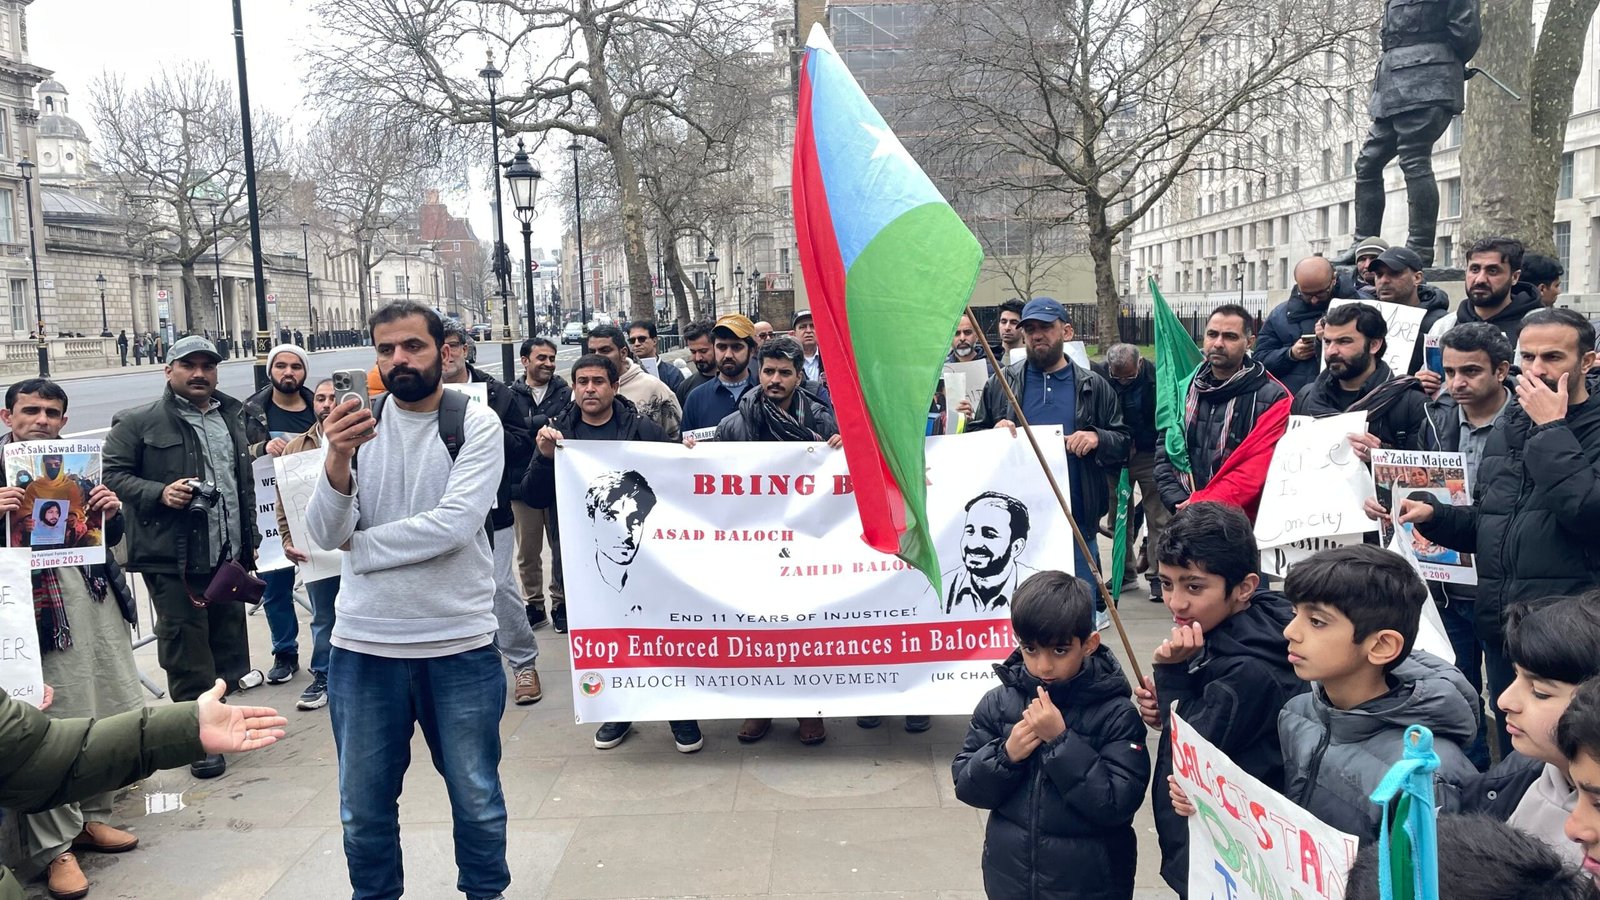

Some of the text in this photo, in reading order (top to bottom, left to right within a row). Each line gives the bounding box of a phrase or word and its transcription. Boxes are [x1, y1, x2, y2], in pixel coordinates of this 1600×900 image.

[27, 445, 46, 454] Saki
[48, 444, 75, 453] Sawad
[77, 443, 100, 453] Baloch
[1390, 453, 1418, 465] Zakir
[1421, 455, 1462, 468] Majeed
[693, 474, 815, 496] BRING
[259, 503, 275, 513] INT
[652, 528, 794, 542] ASAD BALOCH
[778, 547, 791, 559] &
[30, 559, 41, 567] 05
[62, 555, 84, 564] 2023
[779, 560, 918, 577] ZAHID BALOC
[1429, 570, 1450, 580] 2009
[711, 613, 727, 623] 11
[573, 625, 1019, 664] Stop Enforced Disappearances in Balochis
[611, 675, 687, 689] BALOCH
[695, 673, 786, 688] NATIONAL
[793, 672, 900, 686] MOVEMENT
[931, 672, 955, 683] (UK
[960, 671, 998, 681] CHAP
